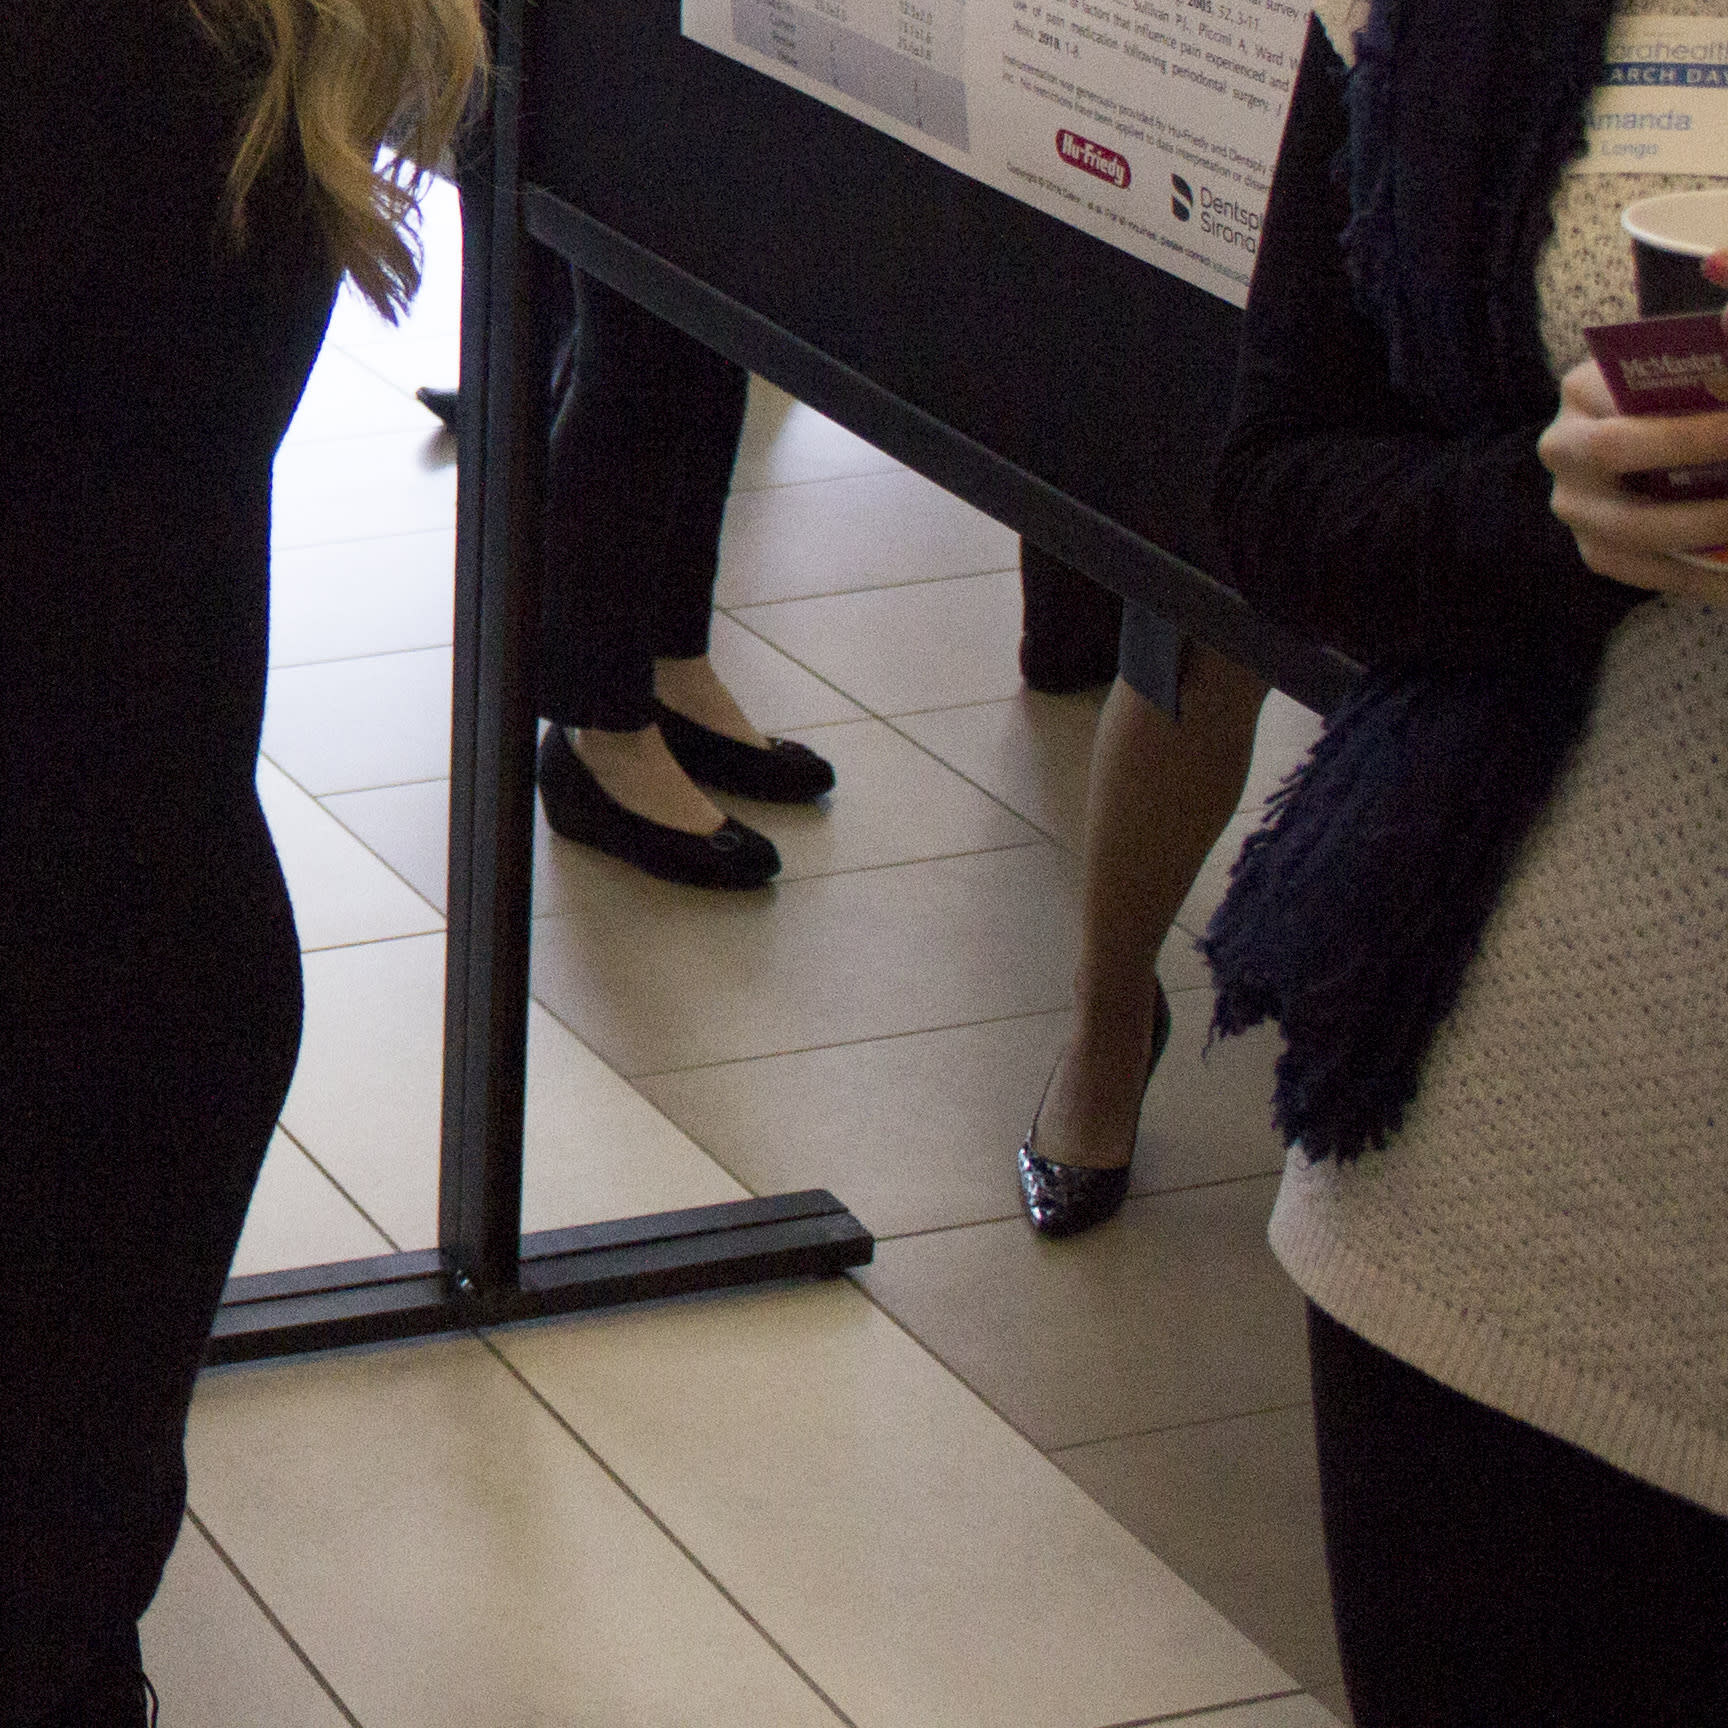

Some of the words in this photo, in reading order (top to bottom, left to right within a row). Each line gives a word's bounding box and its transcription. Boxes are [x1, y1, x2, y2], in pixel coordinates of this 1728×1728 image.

[1610, 68, 1675, 83] ARCH
[1062, 133, 1126, 184] Hu-Friedy
[1200, 212, 1256, 253] Sirona
